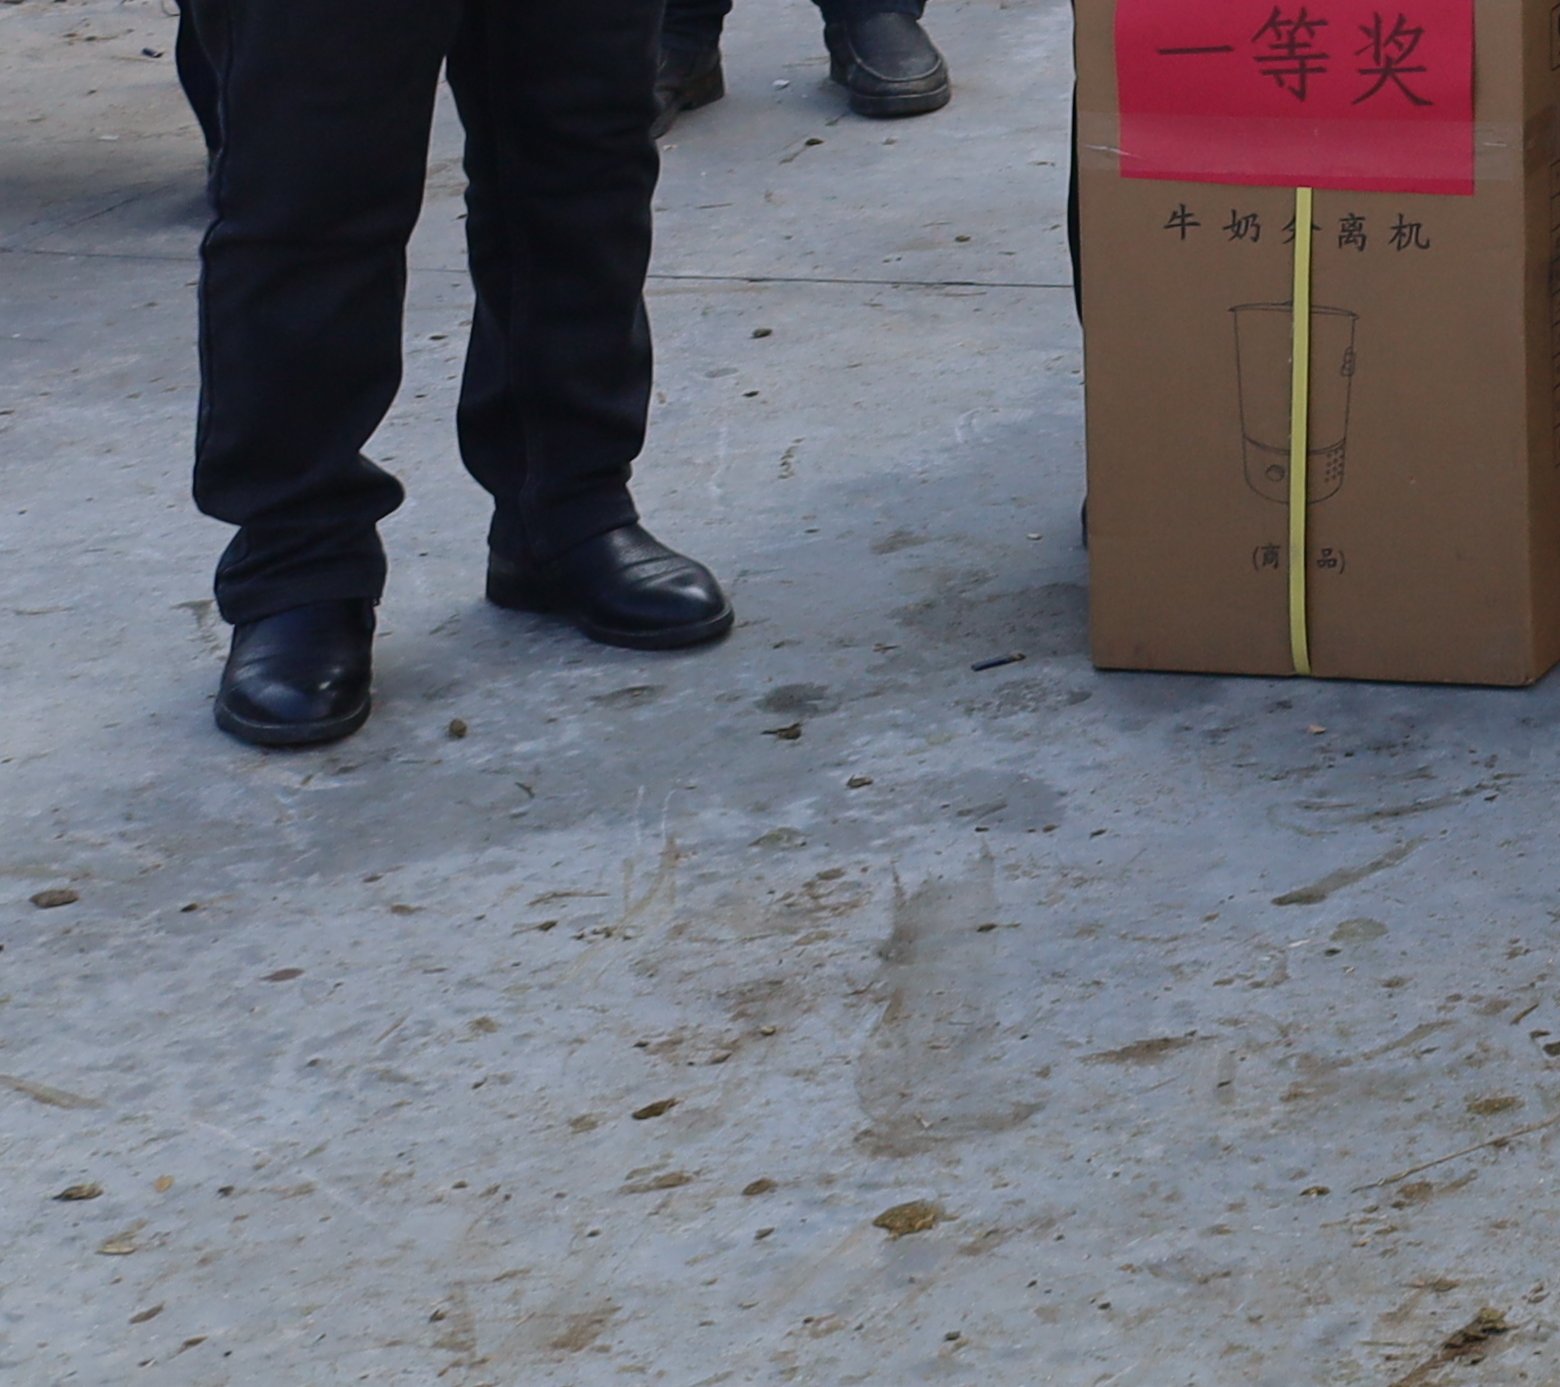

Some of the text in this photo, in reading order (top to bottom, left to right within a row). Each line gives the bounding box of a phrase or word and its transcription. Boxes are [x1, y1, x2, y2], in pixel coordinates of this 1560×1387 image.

[1157, 6, 1433, 107] 一等奖
[1252, 544, 1345, 573] (商品)
